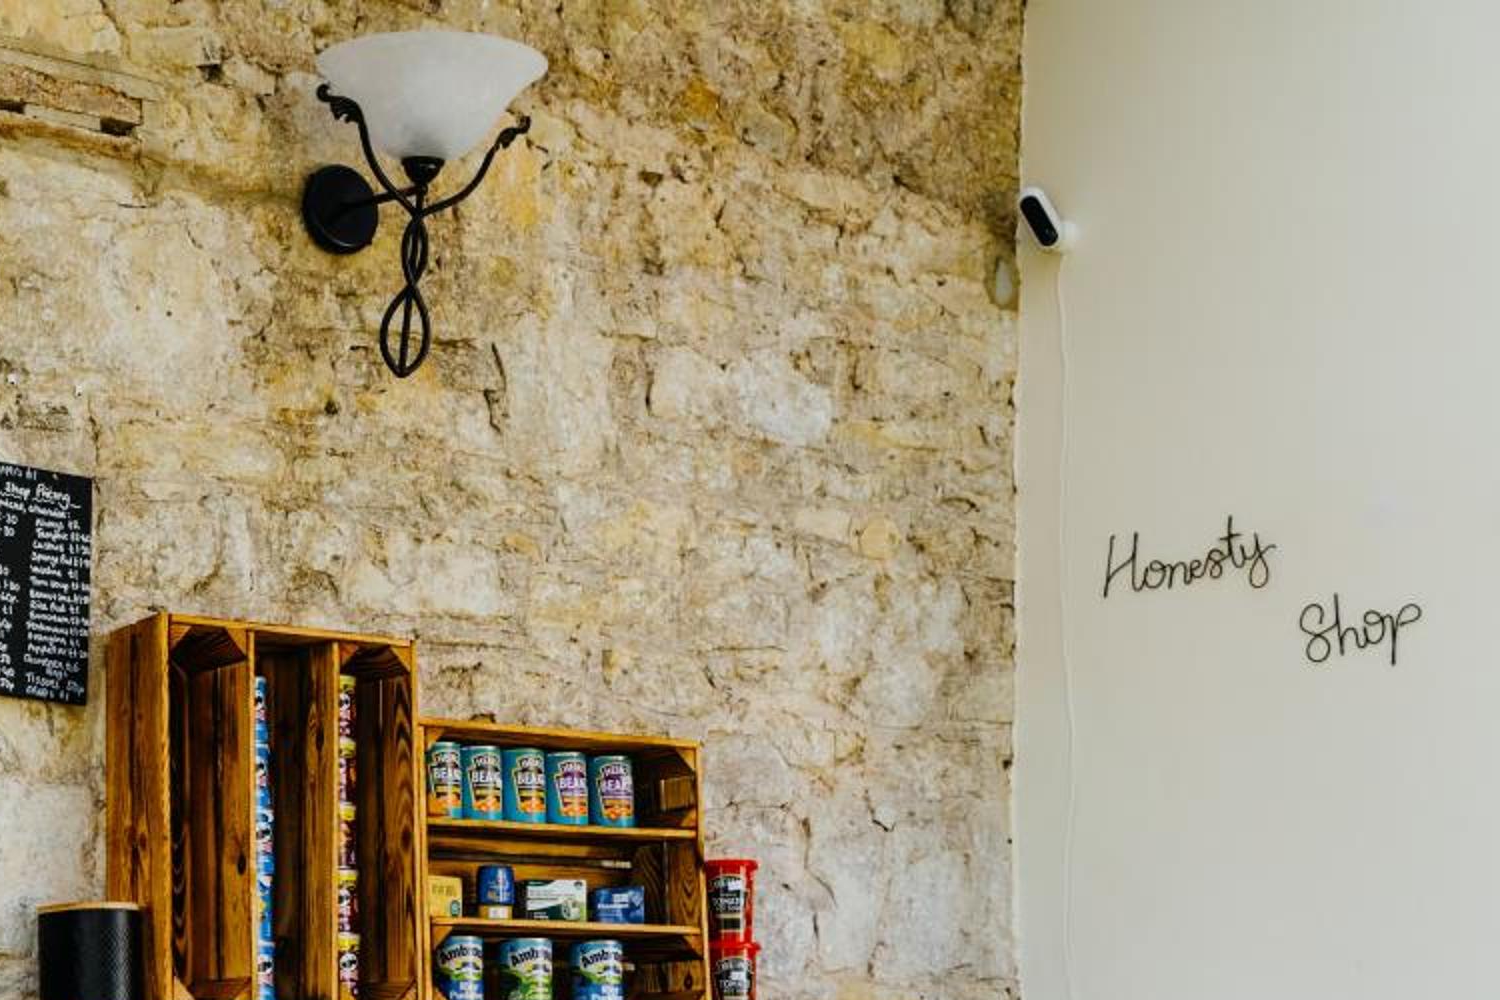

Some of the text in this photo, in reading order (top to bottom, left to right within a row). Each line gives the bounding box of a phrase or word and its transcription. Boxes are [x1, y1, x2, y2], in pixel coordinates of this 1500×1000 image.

[4, 481, 31, 501] Shop
[1102, 514, 1276, 598] Honesty
[1299, 593, 1422, 666] Shop
